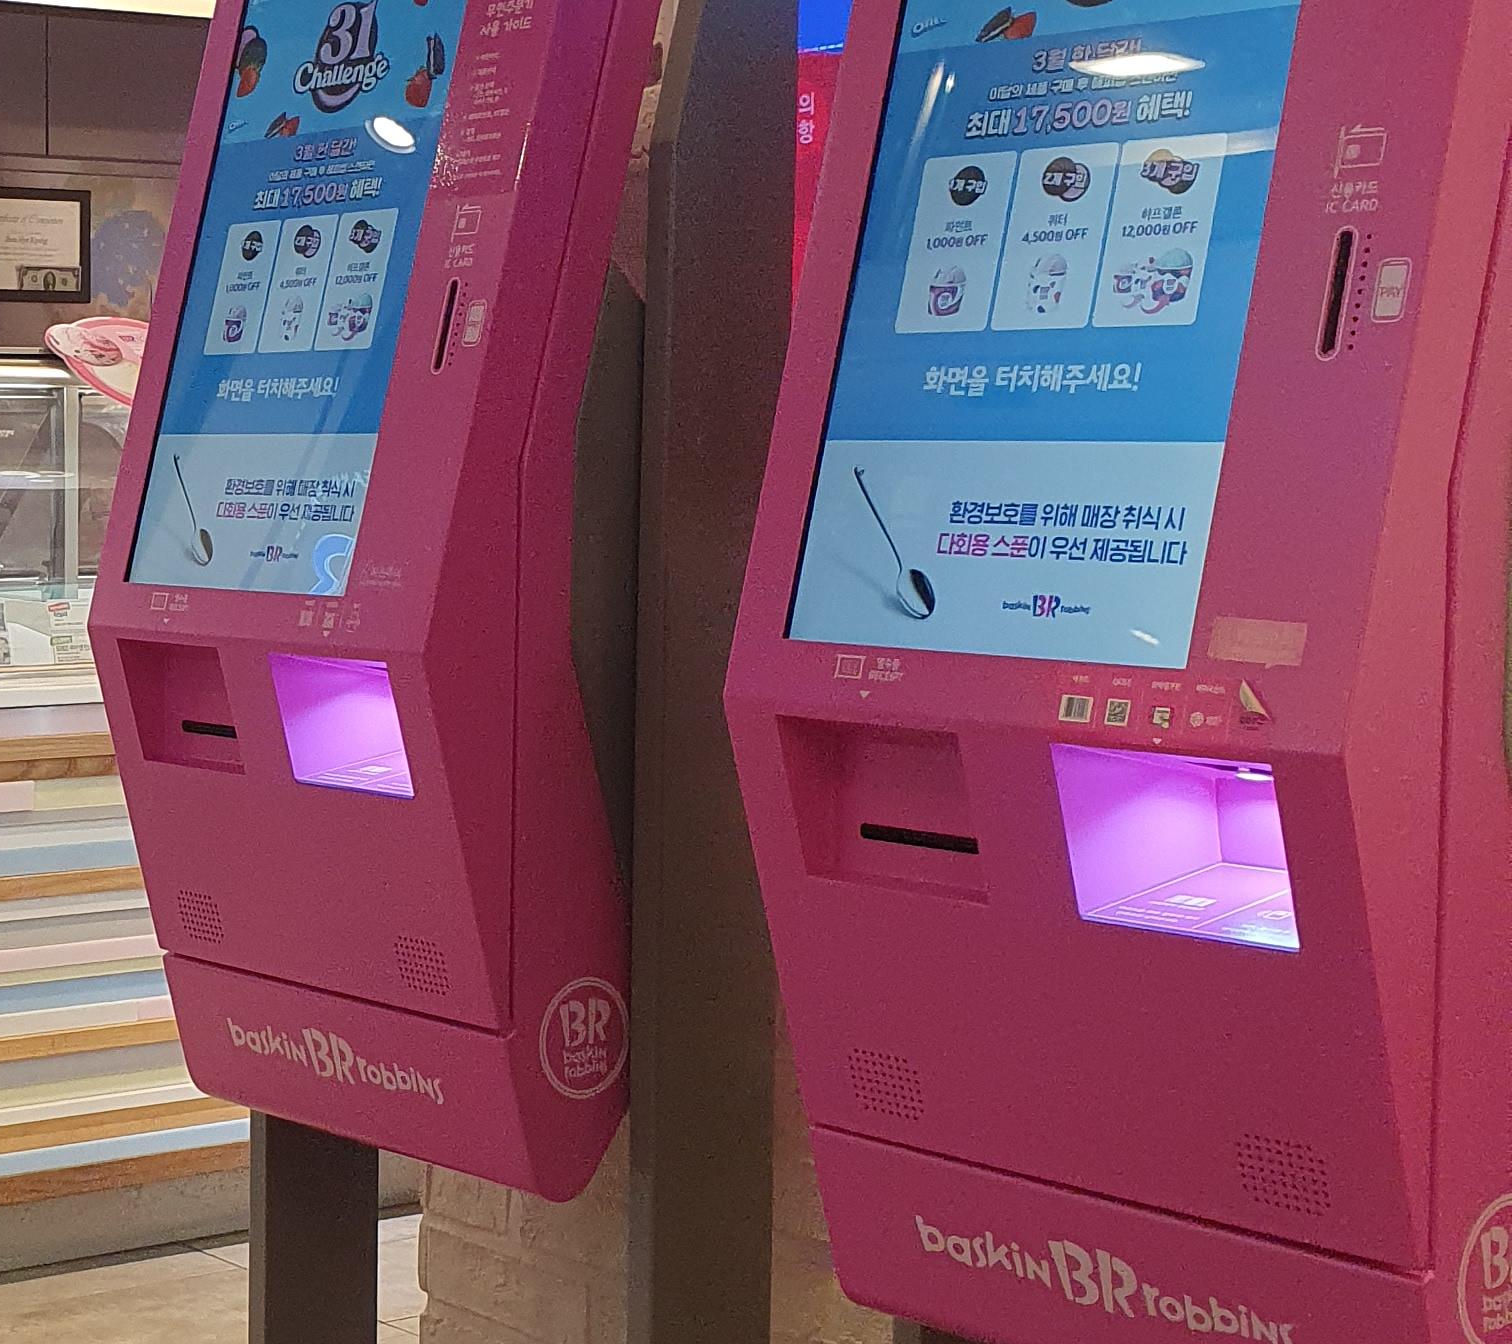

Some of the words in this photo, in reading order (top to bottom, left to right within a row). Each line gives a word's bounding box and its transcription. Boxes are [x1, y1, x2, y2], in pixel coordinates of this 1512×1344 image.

[1032, 48, 1067, 73] 3월
[295, 52, 388, 95] Challenge
[966, 107, 1012, 138] 최대
[1014, 98, 1131, 134] 17,500원
[1136, 90, 1192, 121] 혜택!
[1043, 172, 1061, 186] 2개
[1063, 171, 1087, 188] 구입
[1142, 161, 1166, 177] 3개
[1167, 162, 1199, 181] 구입
[254, 189, 280, 210] 최대
[281, 183, 348, 206] 17,500원
[965, 178, 986, 194] 구입
[1325, 203, 1336, 214] IC
[1343, 199, 1378, 212] CARD
[1065, 228, 1088, 241] OFF
[1172, 221, 1198, 234] OFF
[965, 234, 988, 246] OFF
[1379, 286, 1403, 297] PAY
[217, 380, 254, 402] 화면을
[258, 377, 339, 399] 터치해주세요!
[924, 364, 990, 397] 화면을
[995, 363, 1141, 394] 터치해주세요!
[225, 479, 274, 495] 환경보호를
[343, 480, 355, 497] 시
[279, 503, 300, 520] 우선
[948, 500, 1037, 527] 환경보호를
[1039, 503, 1077, 528] 위해
[1081, 505, 1119, 531] 매장
[1122, 505, 1160, 531] 취식
[1165, 506, 1185, 532] 시
[936, 533, 988, 557] 다회용
[991, 534, 1046, 559] 스푼이
[1049, 537, 1086, 562] 우선
[1090, 538, 1188, 565] 제공됩니다
[1032, 594, 1059, 618] BR
[559, 997, 611, 1047] BR
[226, 1018, 306, 1068] baskin
[304, 1027, 356, 1085] BR
[355, 1057, 444, 1104] robbins
[915, 1215, 1053, 1290] baskin
[1048, 1239, 1138, 1318] BR
